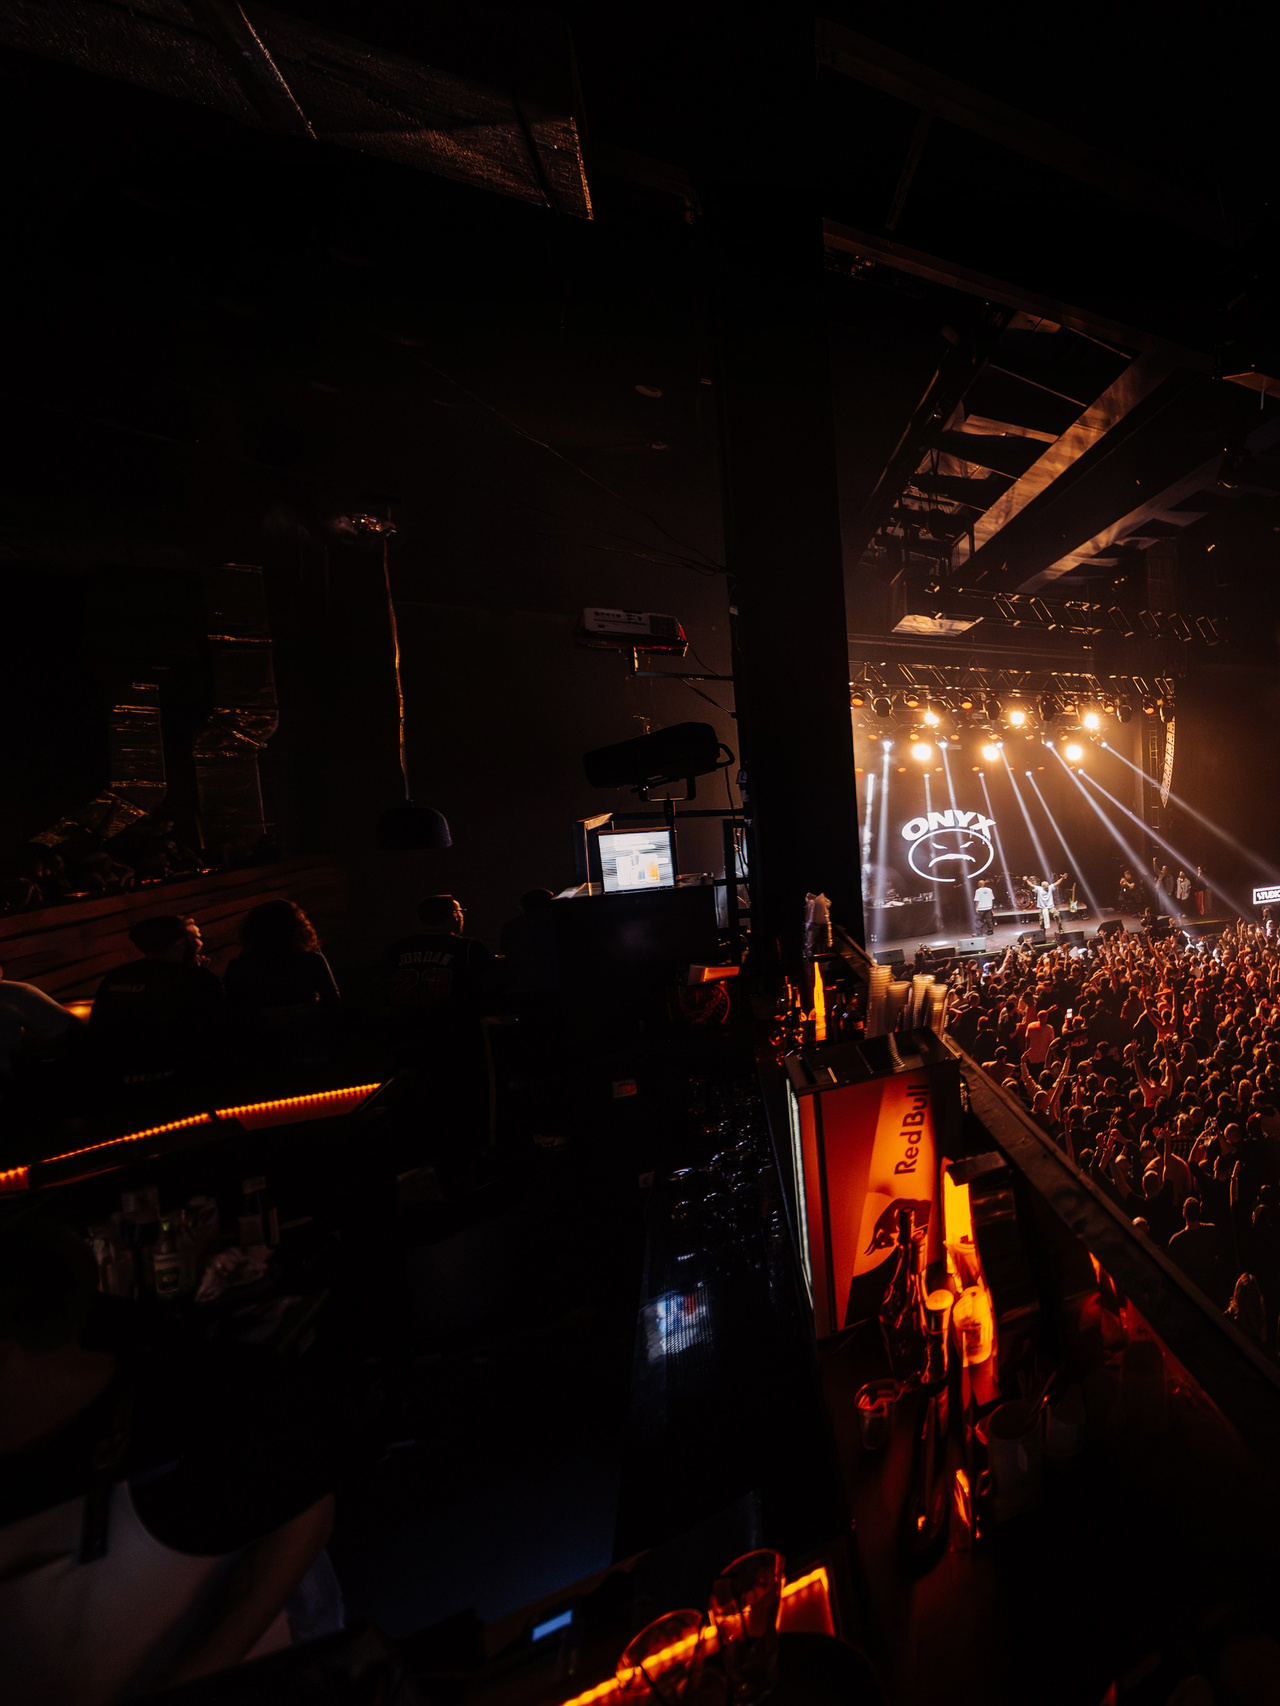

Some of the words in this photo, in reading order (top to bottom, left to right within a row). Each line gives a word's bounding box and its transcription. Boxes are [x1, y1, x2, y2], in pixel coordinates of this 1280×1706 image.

[901, 809, 997, 841] ONYX
[902, 1084, 930, 1128] Bull
[894, 1130, 922, 1175] Red
